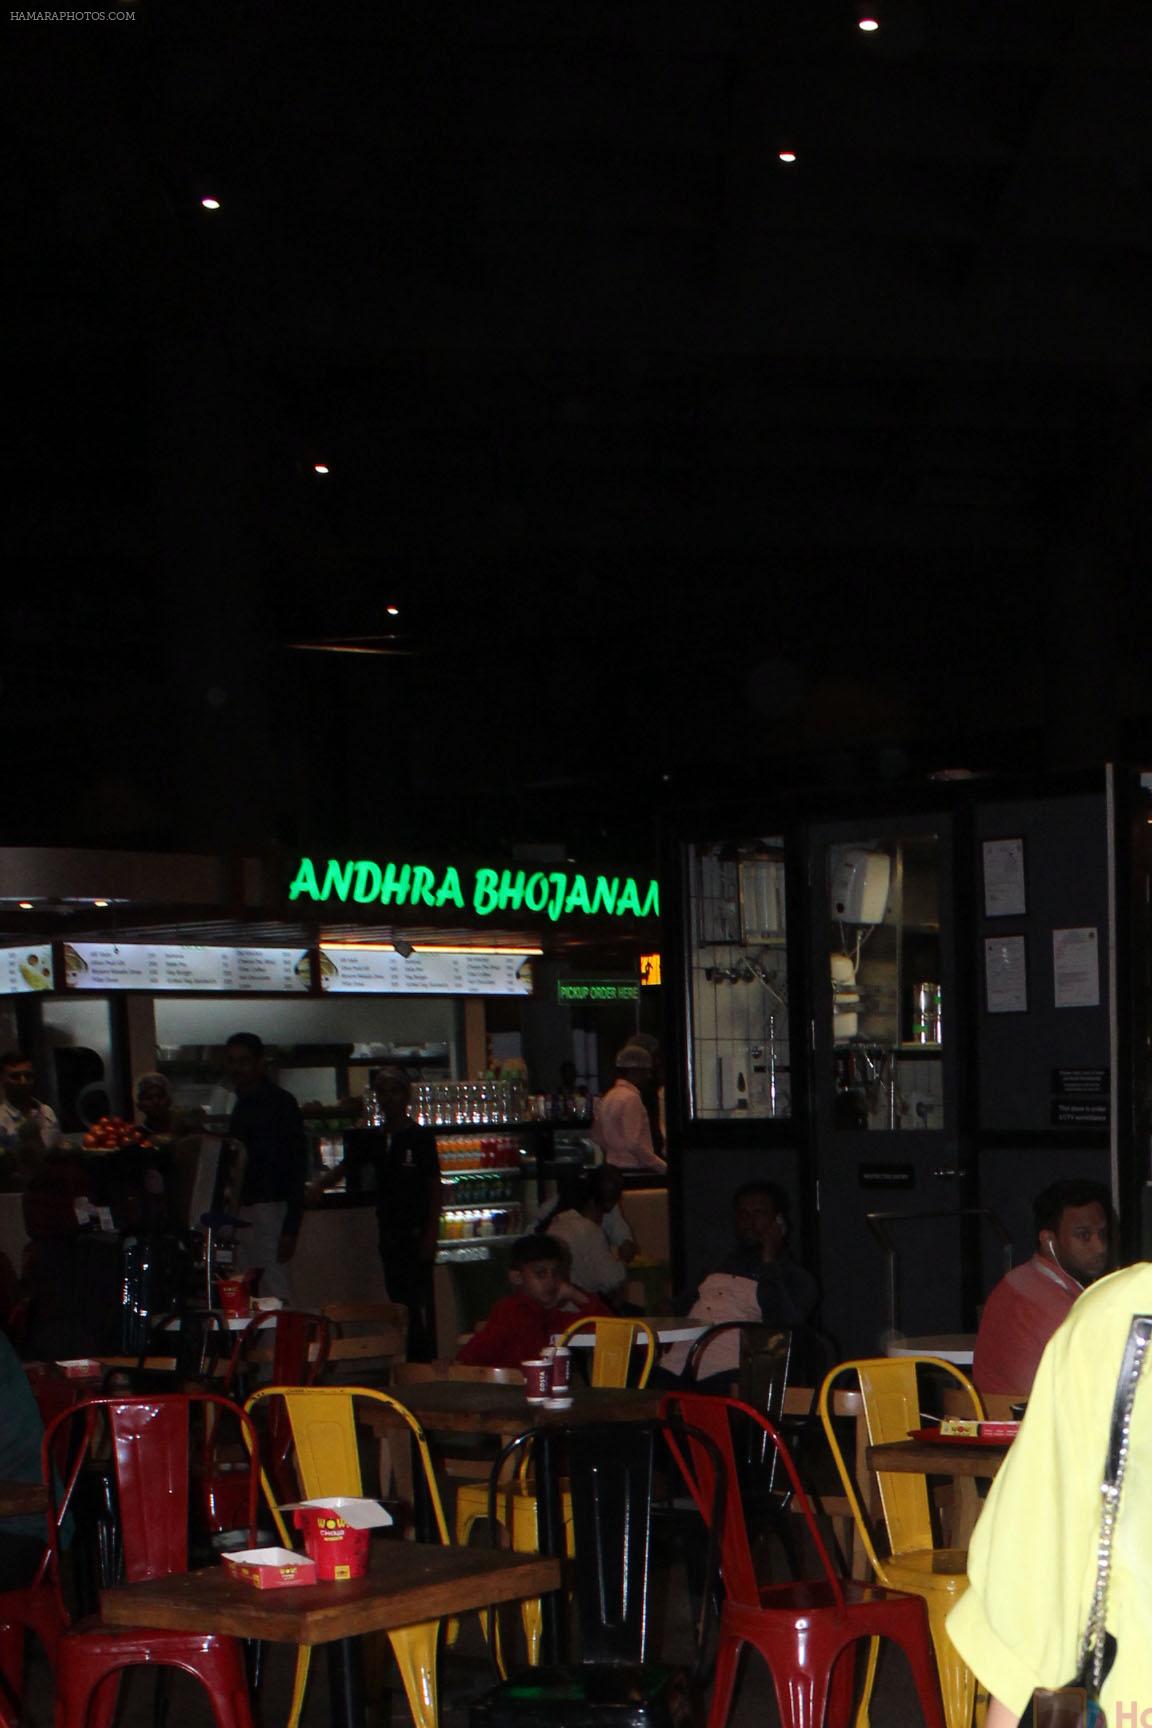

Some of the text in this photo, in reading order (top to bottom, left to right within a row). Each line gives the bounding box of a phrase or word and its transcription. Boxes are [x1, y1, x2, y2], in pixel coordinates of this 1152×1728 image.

[288, 857, 464, 908] ANDHRA
[590, 986, 617, 1000] ORDER
[618, 986, 639, 1000] HERE
